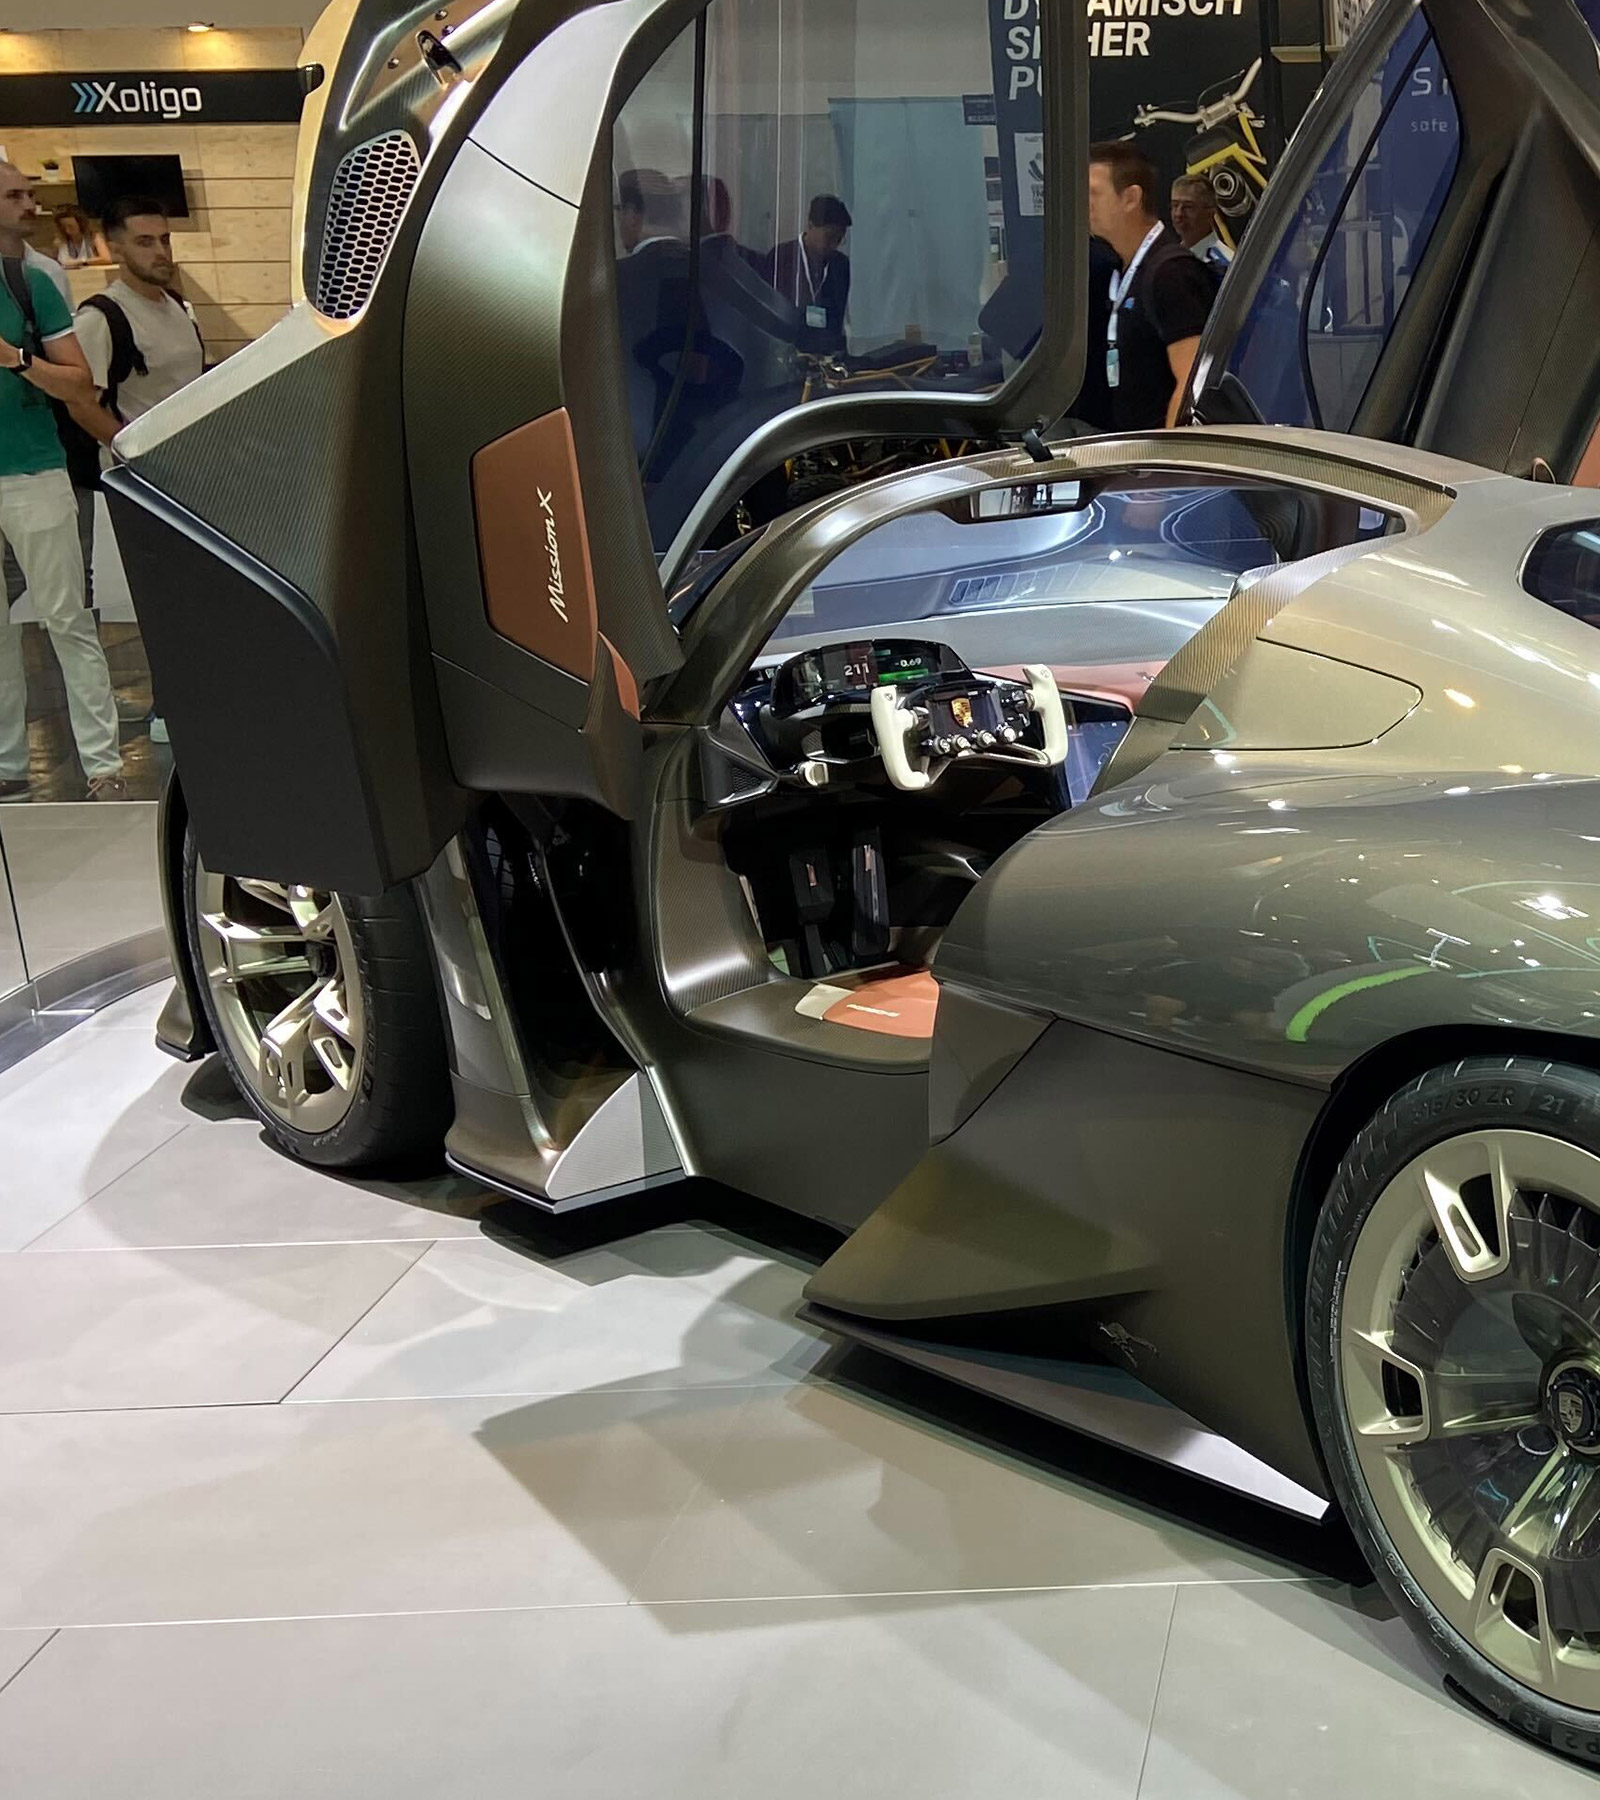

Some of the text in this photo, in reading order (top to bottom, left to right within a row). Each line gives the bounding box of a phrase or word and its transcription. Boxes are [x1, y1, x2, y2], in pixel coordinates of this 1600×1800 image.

[92, 81, 203, 119] Xotigo
[1411, 118, 1449, 133] safe
[536, 485, 570, 624] Mission X
[844, 662, 870, 677] 211
